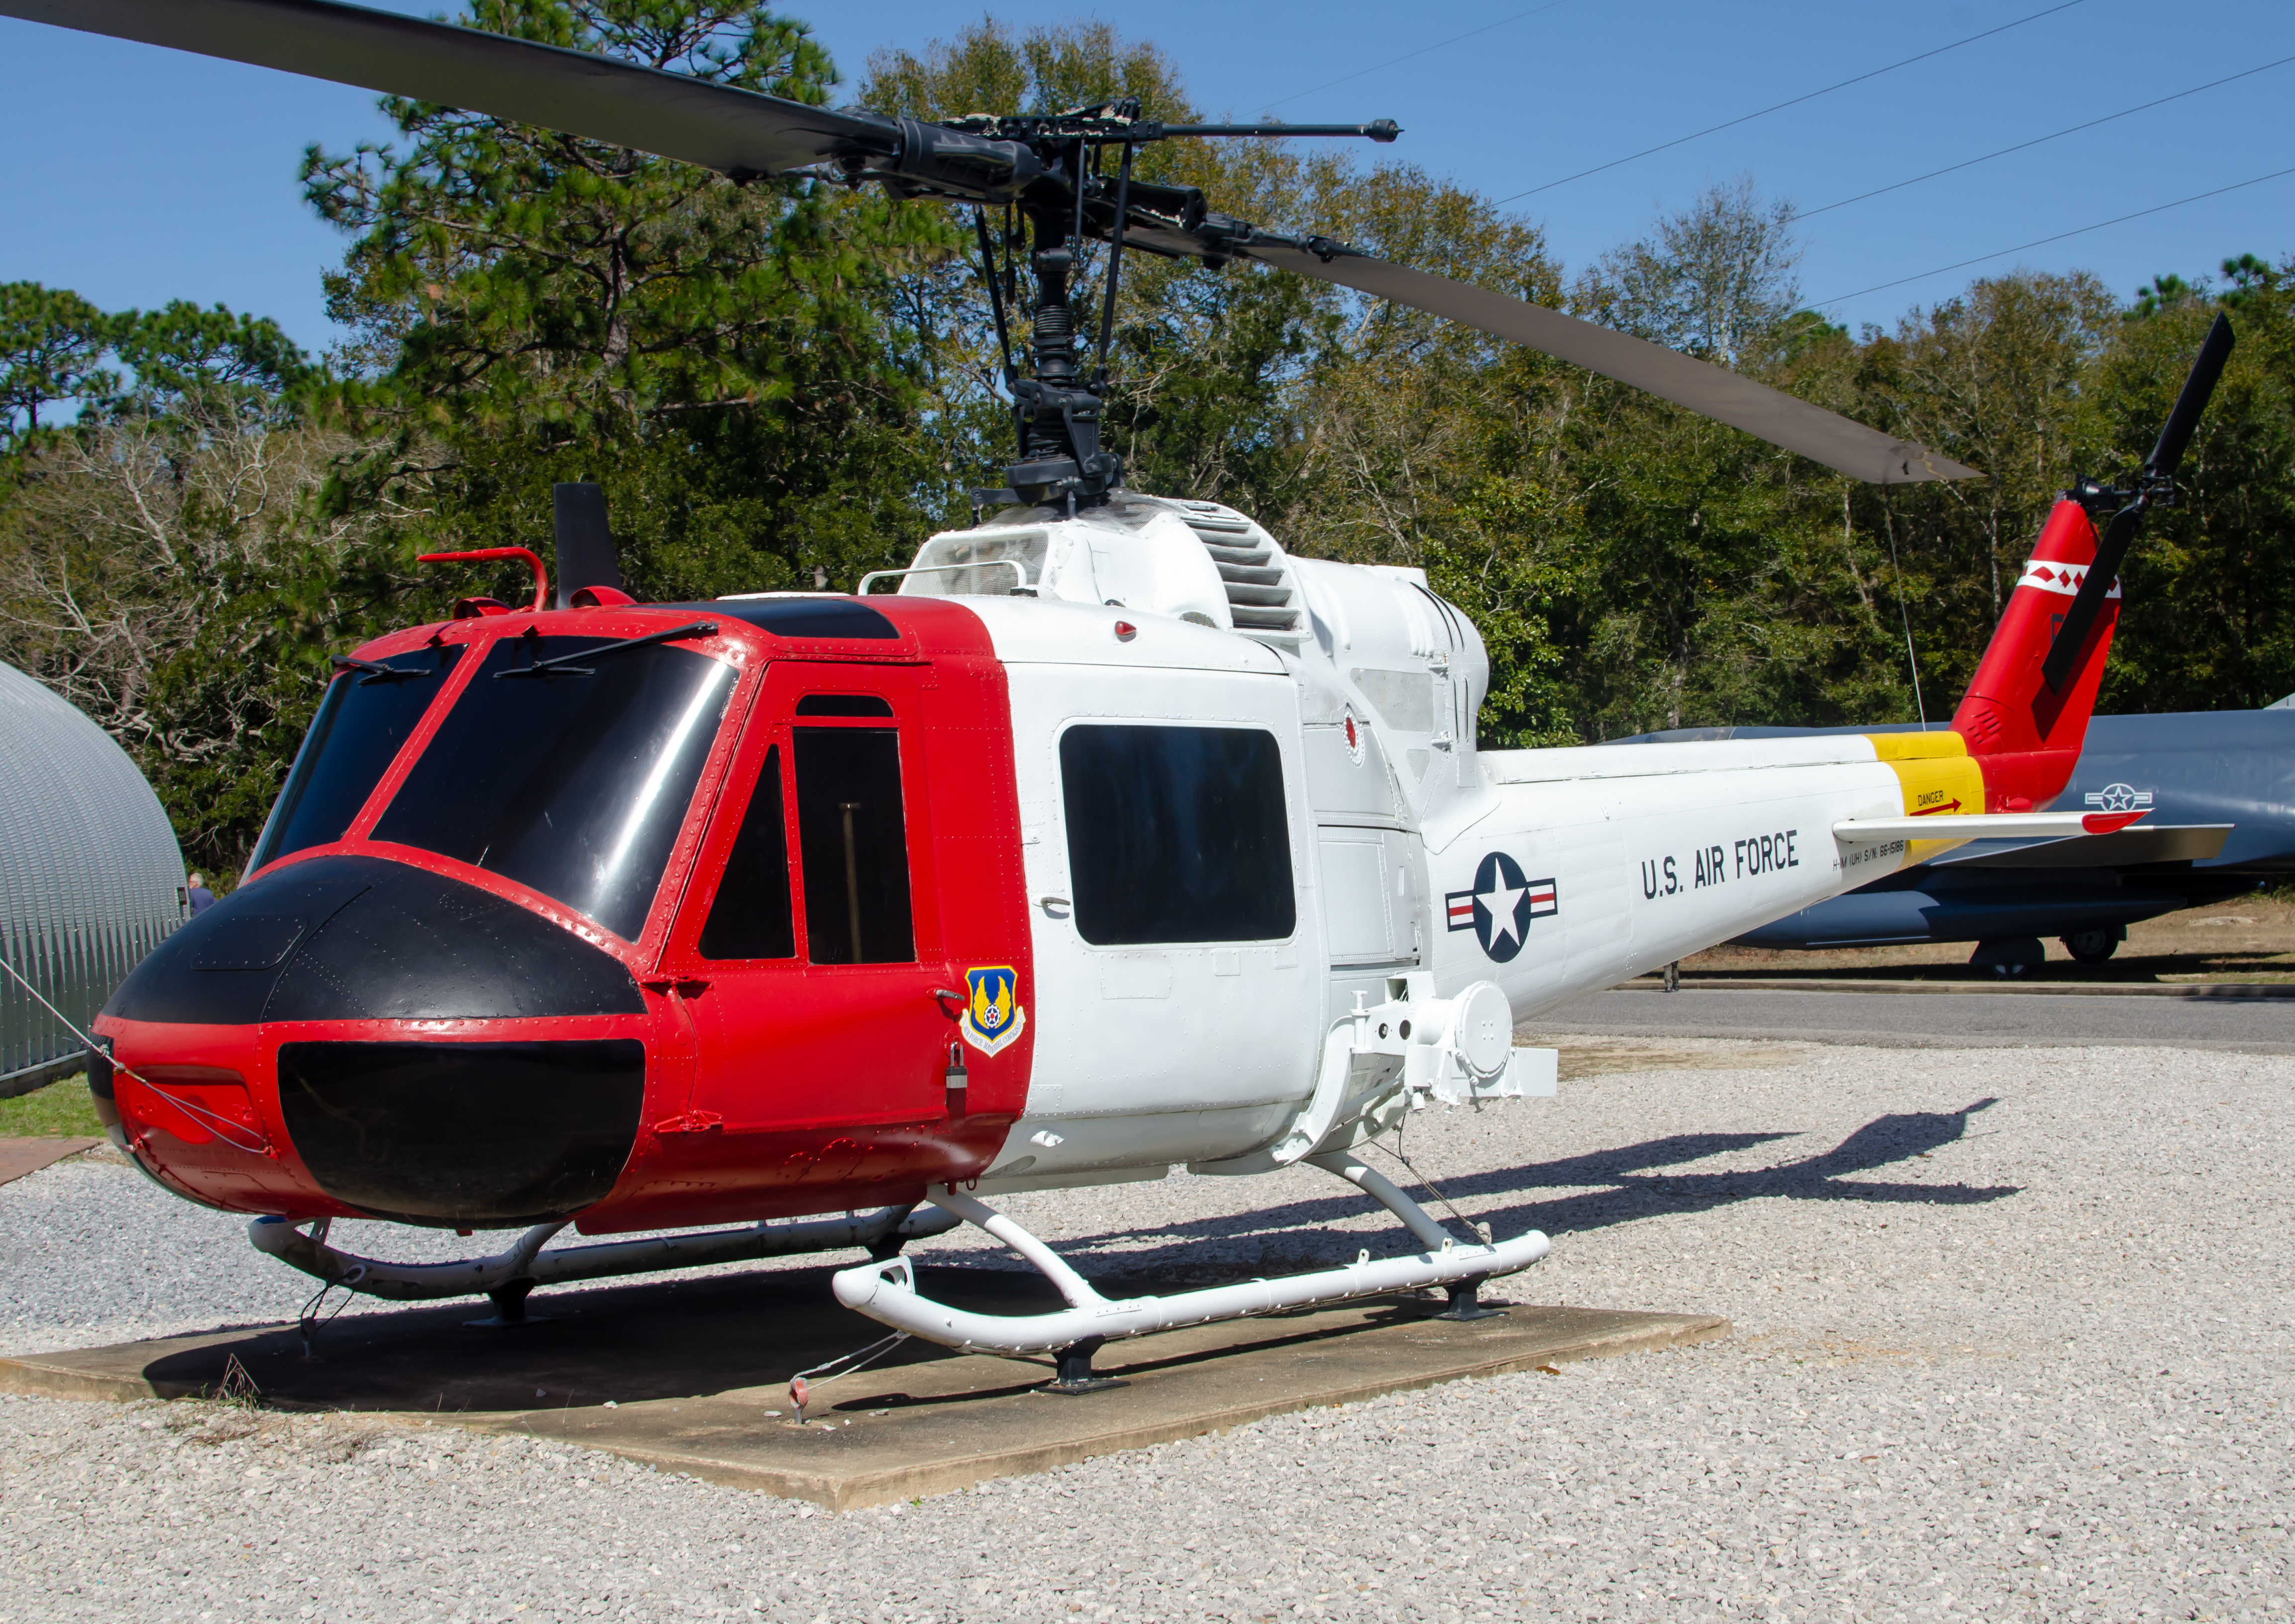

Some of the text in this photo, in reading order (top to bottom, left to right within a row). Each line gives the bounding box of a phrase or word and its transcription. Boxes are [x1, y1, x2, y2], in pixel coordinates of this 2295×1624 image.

[1917, 790, 1944, 807] DANGER
[1641, 829, 1798, 900] U.S. AIR FORCE
[1849, 851, 1862, 867] (UH)
[1880, 840, 1904, 857] 66-15186
[969, 1032, 983, 1046] FORCE
[983, 1039, 1003, 1054] MATERIEL
[1003, 1021, 1022, 1043] COMMAND
